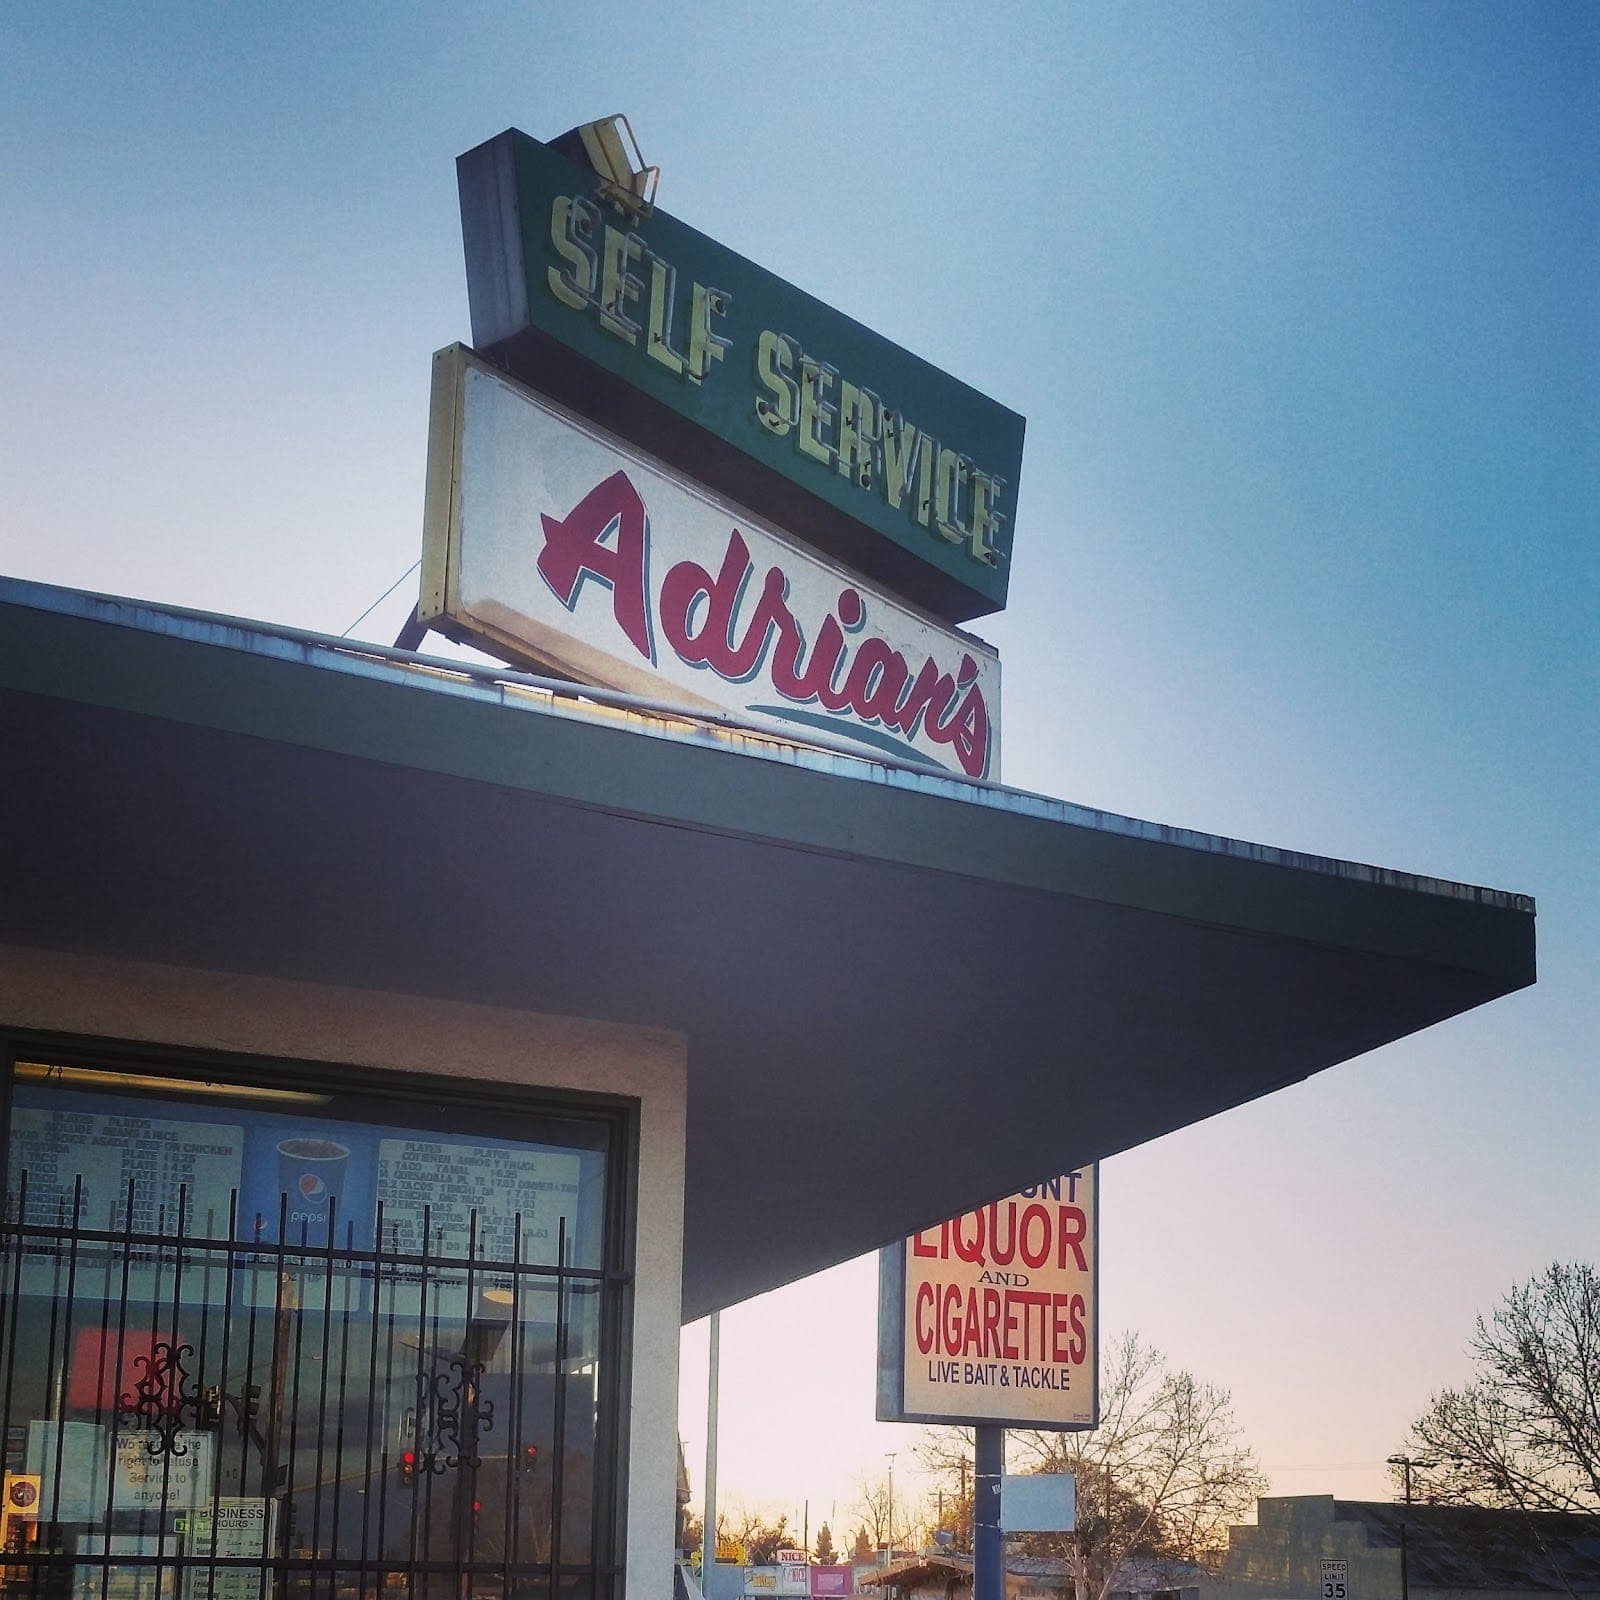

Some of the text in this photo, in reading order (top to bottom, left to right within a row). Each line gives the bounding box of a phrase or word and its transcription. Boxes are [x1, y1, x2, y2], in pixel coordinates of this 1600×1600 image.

[547, 194, 733, 386] SELF
[755, 329, 1005, 570] SERVICE
[536, 469, 991, 779] Adrian's
[290, 1210, 328, 1225] pepsi
[913, 1201, 1089, 1272] LIQUOR
[978, 1270, 1030, 1287] AND
[915, 1281, 1087, 1365] CIGARETTES
[928, 1359, 1070, 1391] LIVE BAIT & TACKLE
[162, 1456, 199, 1468] efuse
[174, 1472, 187, 1484] to
[133, 1489, 180, 1503] anyoe!
[199, 1508, 264, 1520] BUSINESS
[781, 1551, 805, 1562] NICE
[1322, 1563, 1347, 1571] SPEED
[1324, 1573, 1345, 1581] LIMIT
[1324, 1582, 1346, 1599] 35
